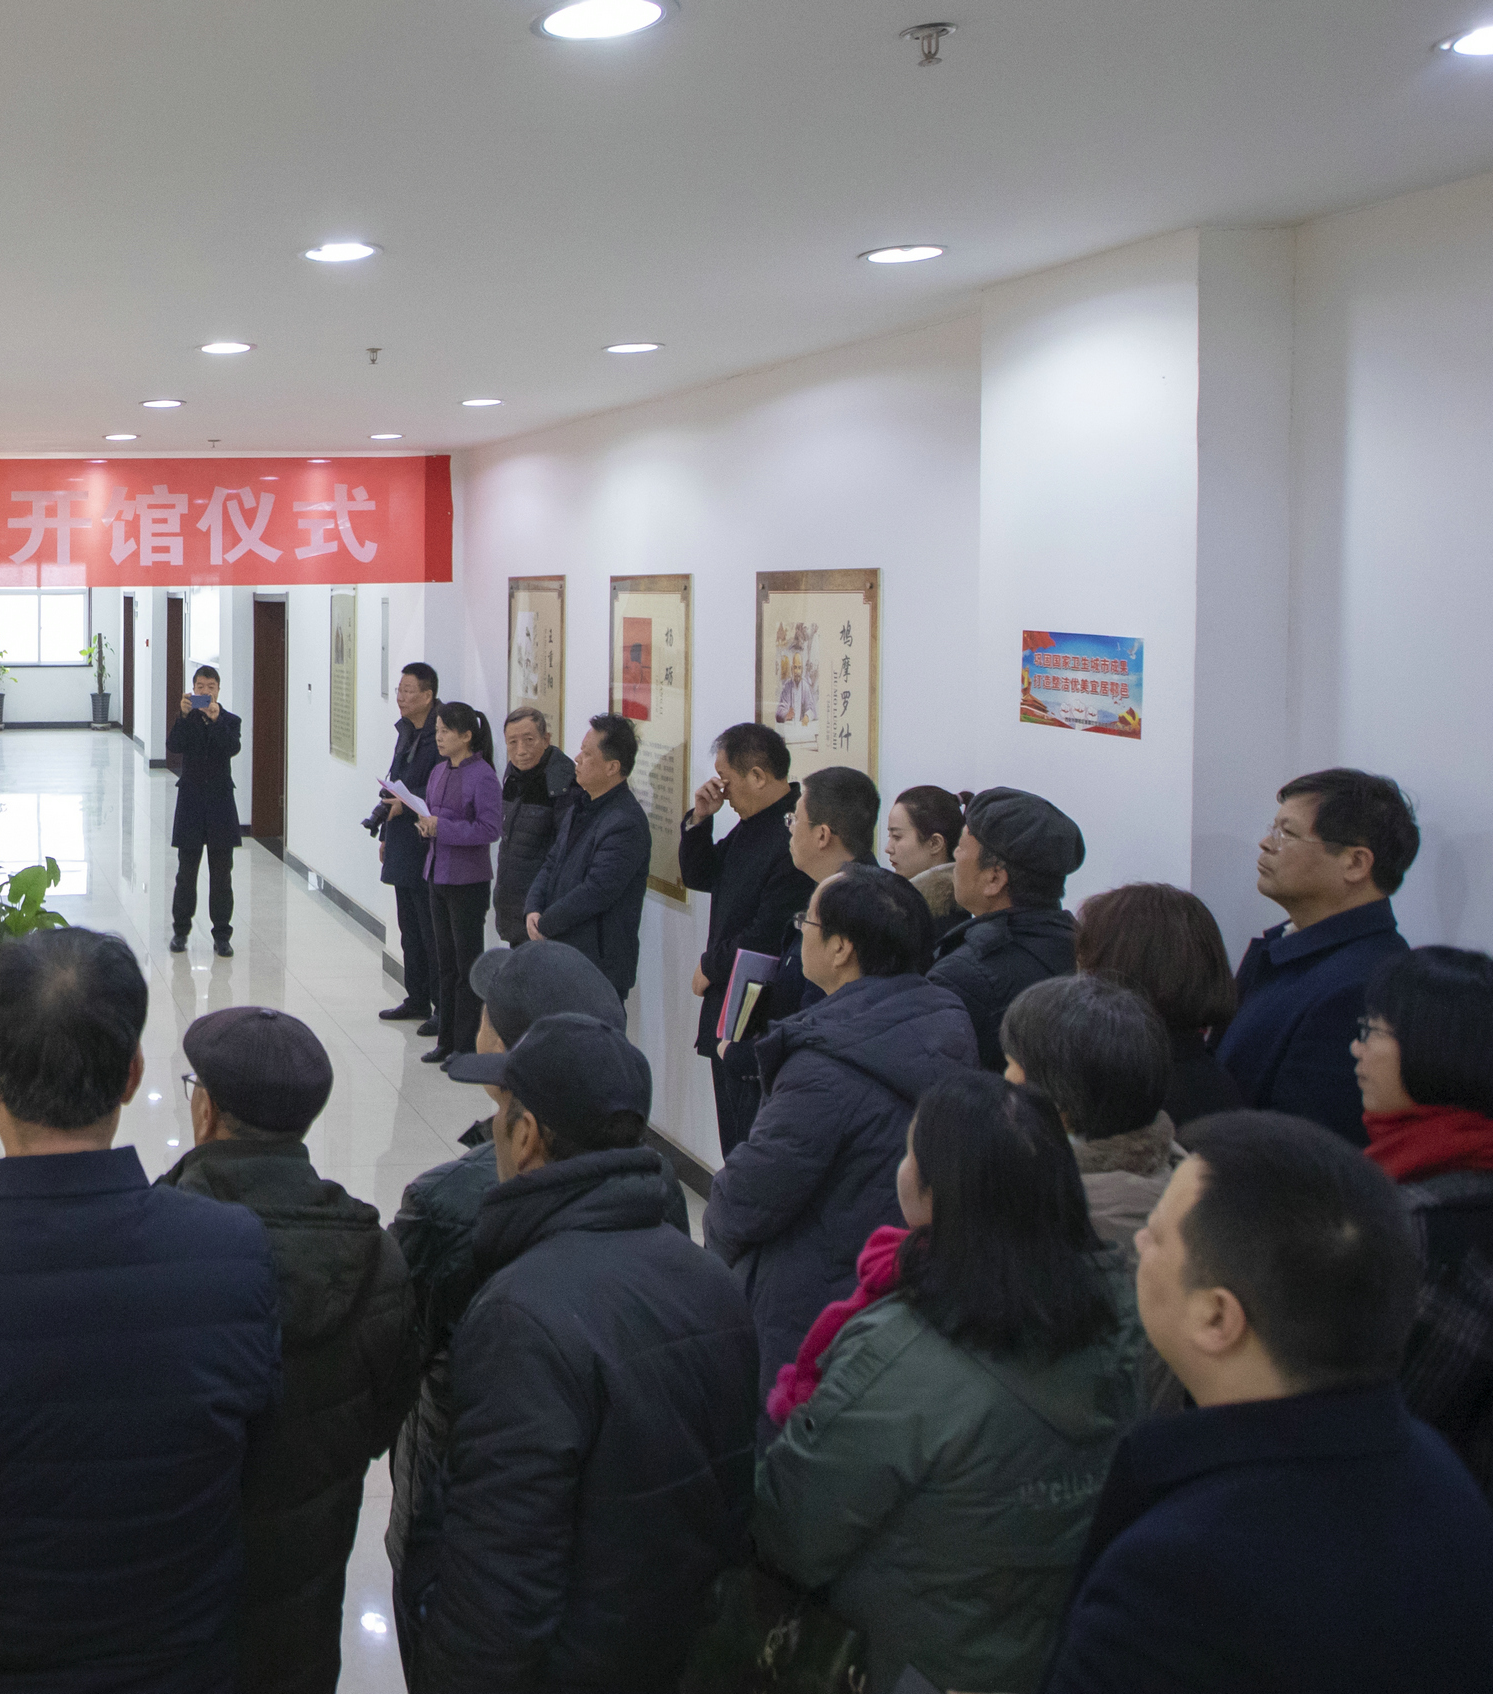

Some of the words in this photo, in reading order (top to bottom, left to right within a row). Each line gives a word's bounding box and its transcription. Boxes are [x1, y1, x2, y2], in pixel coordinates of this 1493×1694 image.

[839, 620, 853, 752] 鸠摩罗什
[1034, 653, 1129, 676] 巩固国家卫生城市成果
